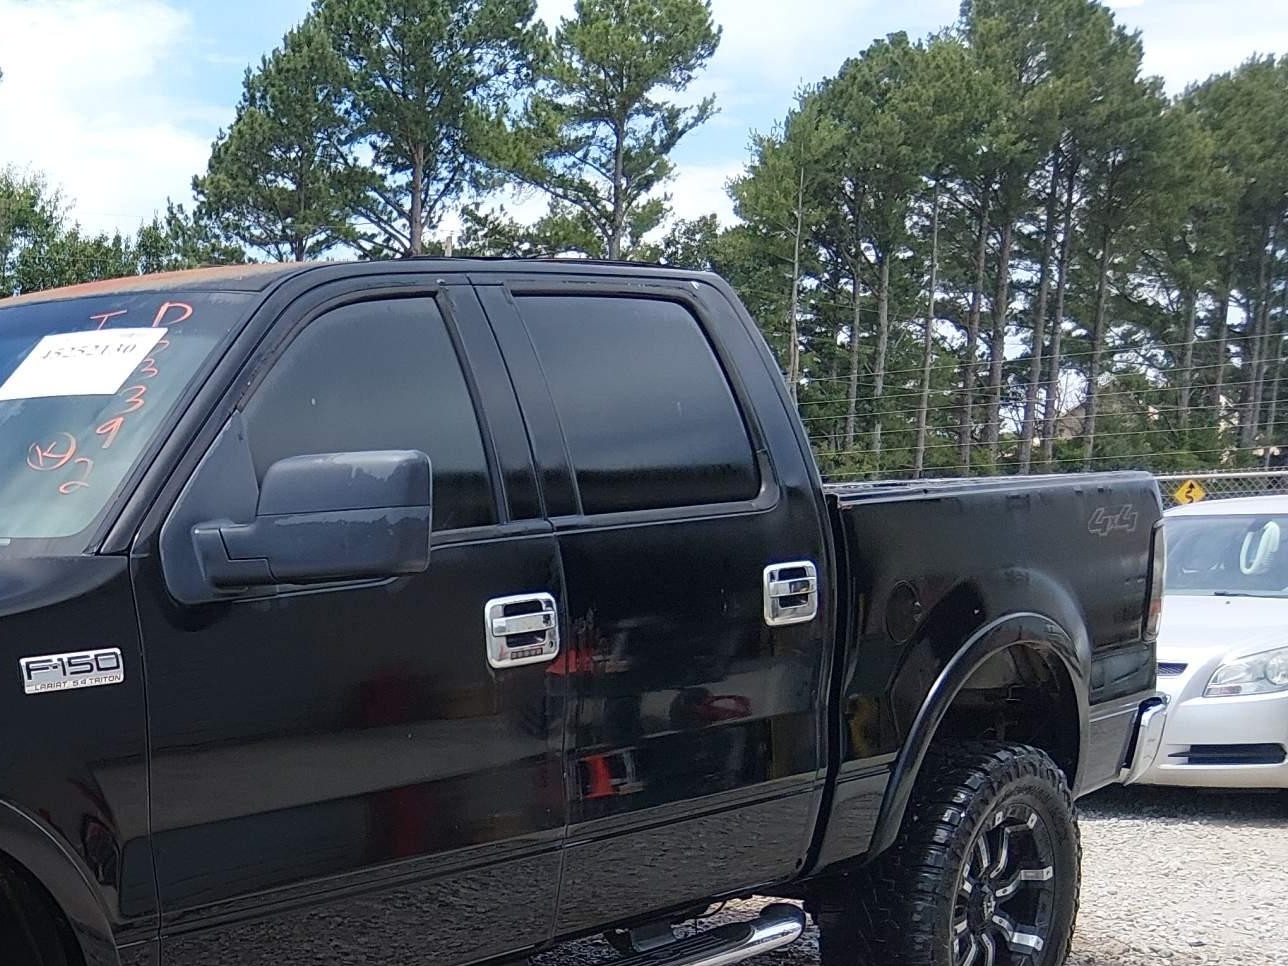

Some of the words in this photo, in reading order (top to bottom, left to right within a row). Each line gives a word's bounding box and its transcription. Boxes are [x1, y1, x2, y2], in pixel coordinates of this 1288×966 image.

[1087, 503, 1139, 537] 4x4
[25, 651, 121, 681] F-150
[34, 680, 68, 692] LARIAT
[72, 679, 87, 687] 54
[88, 674, 122, 684] TRITON
